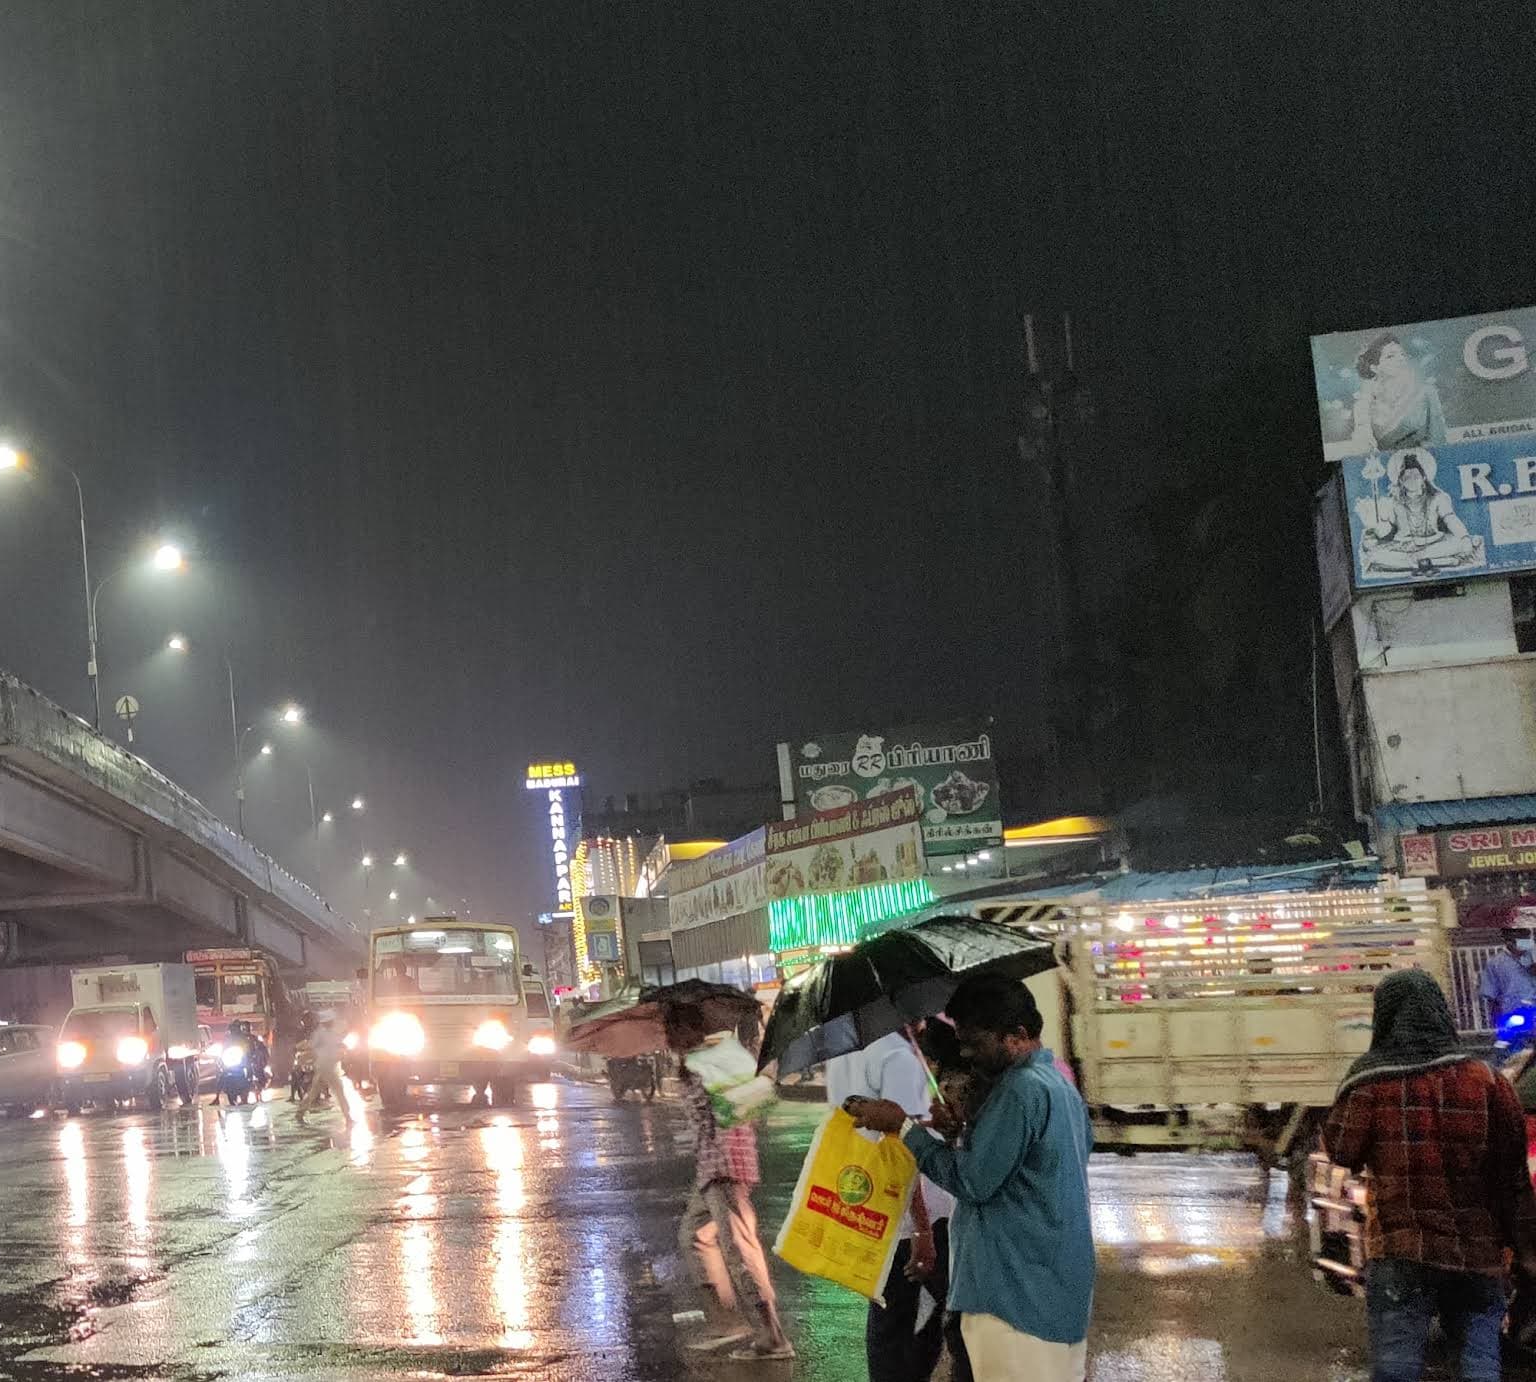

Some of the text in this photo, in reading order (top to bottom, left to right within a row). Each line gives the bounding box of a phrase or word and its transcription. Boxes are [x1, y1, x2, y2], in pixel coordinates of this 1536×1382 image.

[1463, 325, 1529, 380] G
[799, 734, 991, 779] மதுரை RR பிரியாணி
[528, 763, 575, 778] MESS
[1449, 831, 1502, 852] SRI
[1468, 851, 1536, 868] JEWEL JO
